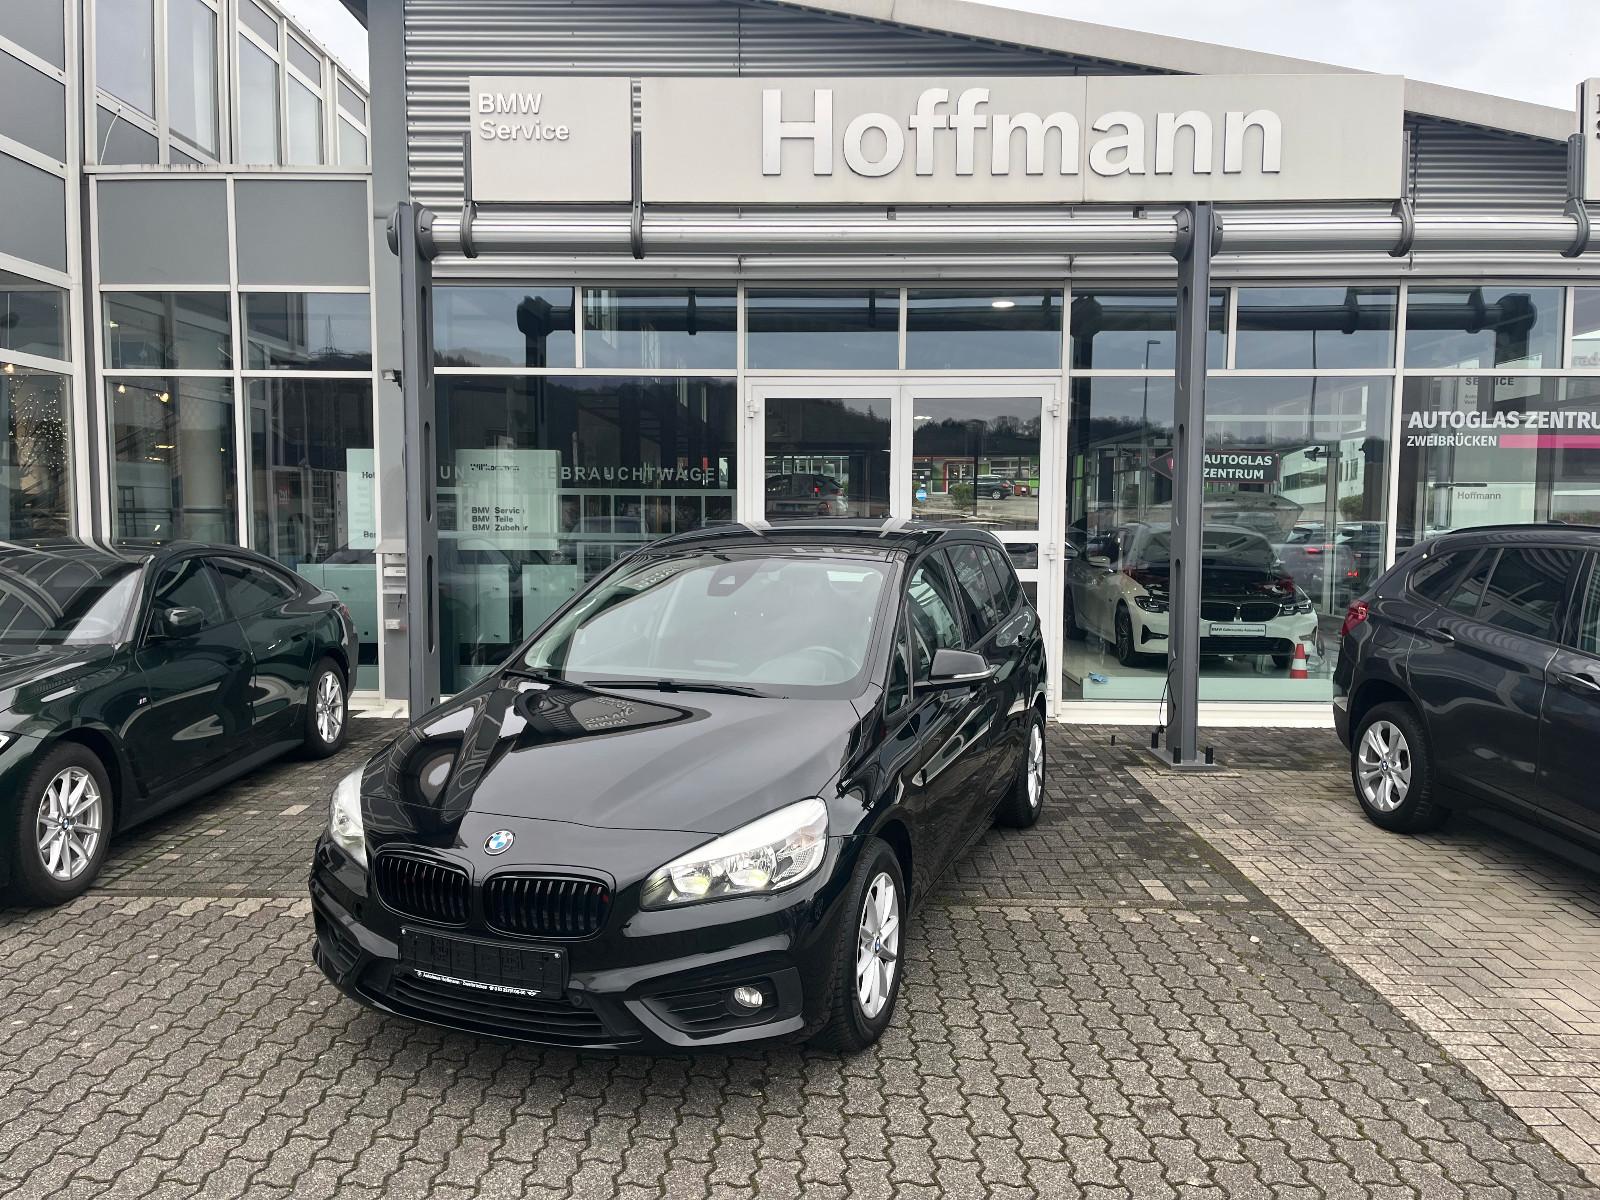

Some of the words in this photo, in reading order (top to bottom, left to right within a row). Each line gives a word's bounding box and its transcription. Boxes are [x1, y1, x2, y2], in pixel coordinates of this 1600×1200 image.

[478, 93, 543, 115] BMW
[479, 120, 570, 141] Service
[761, 87, 1282, 177] Hoffmann
[1408, 411, 1520, 429] AUTOGLAS
[1406, 433, 1497, 447] ZWEIBRÜCKEN
[1203, 454, 1273, 466] AUTOGLAS
[1203, 469, 1264, 479] ZENTRUM
[1457, 491, 1502, 500] Hoffmann
[494, 506, 525, 514] Servic
[495, 515, 514, 523] Teile
[494, 523, 529, 531] Zubehr
